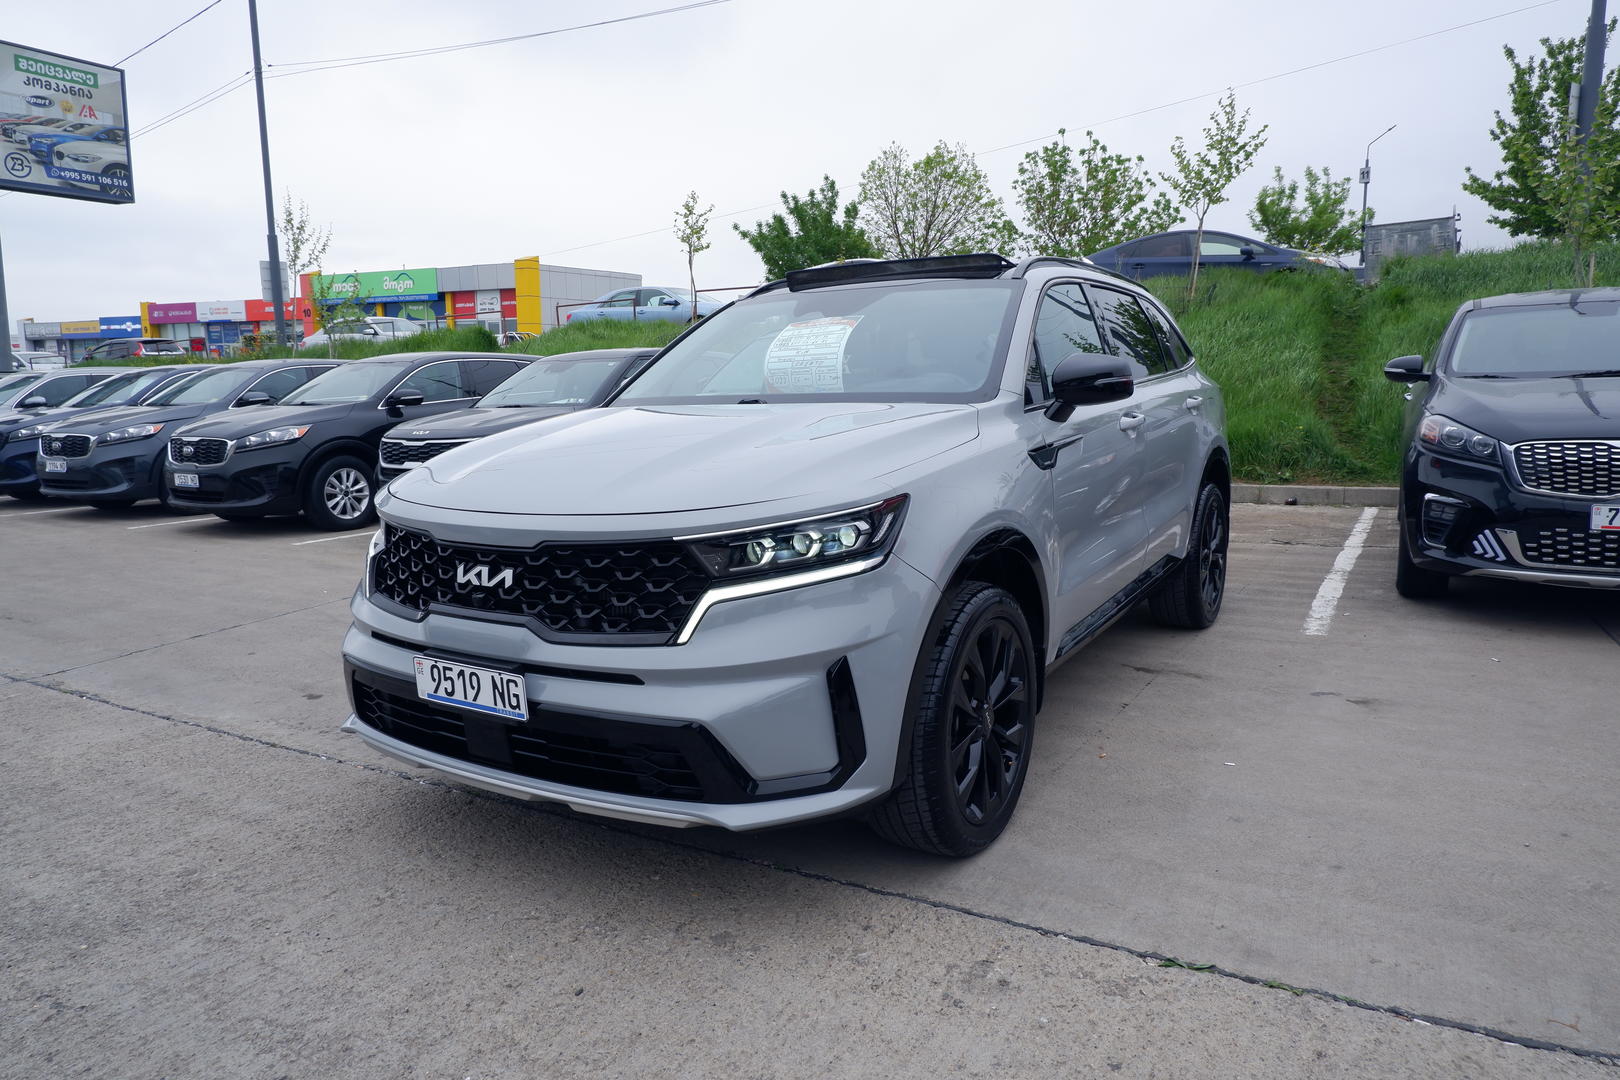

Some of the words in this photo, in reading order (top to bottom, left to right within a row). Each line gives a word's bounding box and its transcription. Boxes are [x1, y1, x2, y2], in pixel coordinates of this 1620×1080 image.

[23, 76, 94, 99] კომპანია
[23, 95, 50, 107] opart
[60, 170, 80, 179] +995
[82, 173, 96, 182] 591
[98, 176, 112, 185] 106
[113, 178, 128, 187] 516
[303, 308, 312, 319] 10
[456, 562, 513, 589] KIA
[430, 663, 481, 702] 9519
[491, 674, 521, 711] NG
